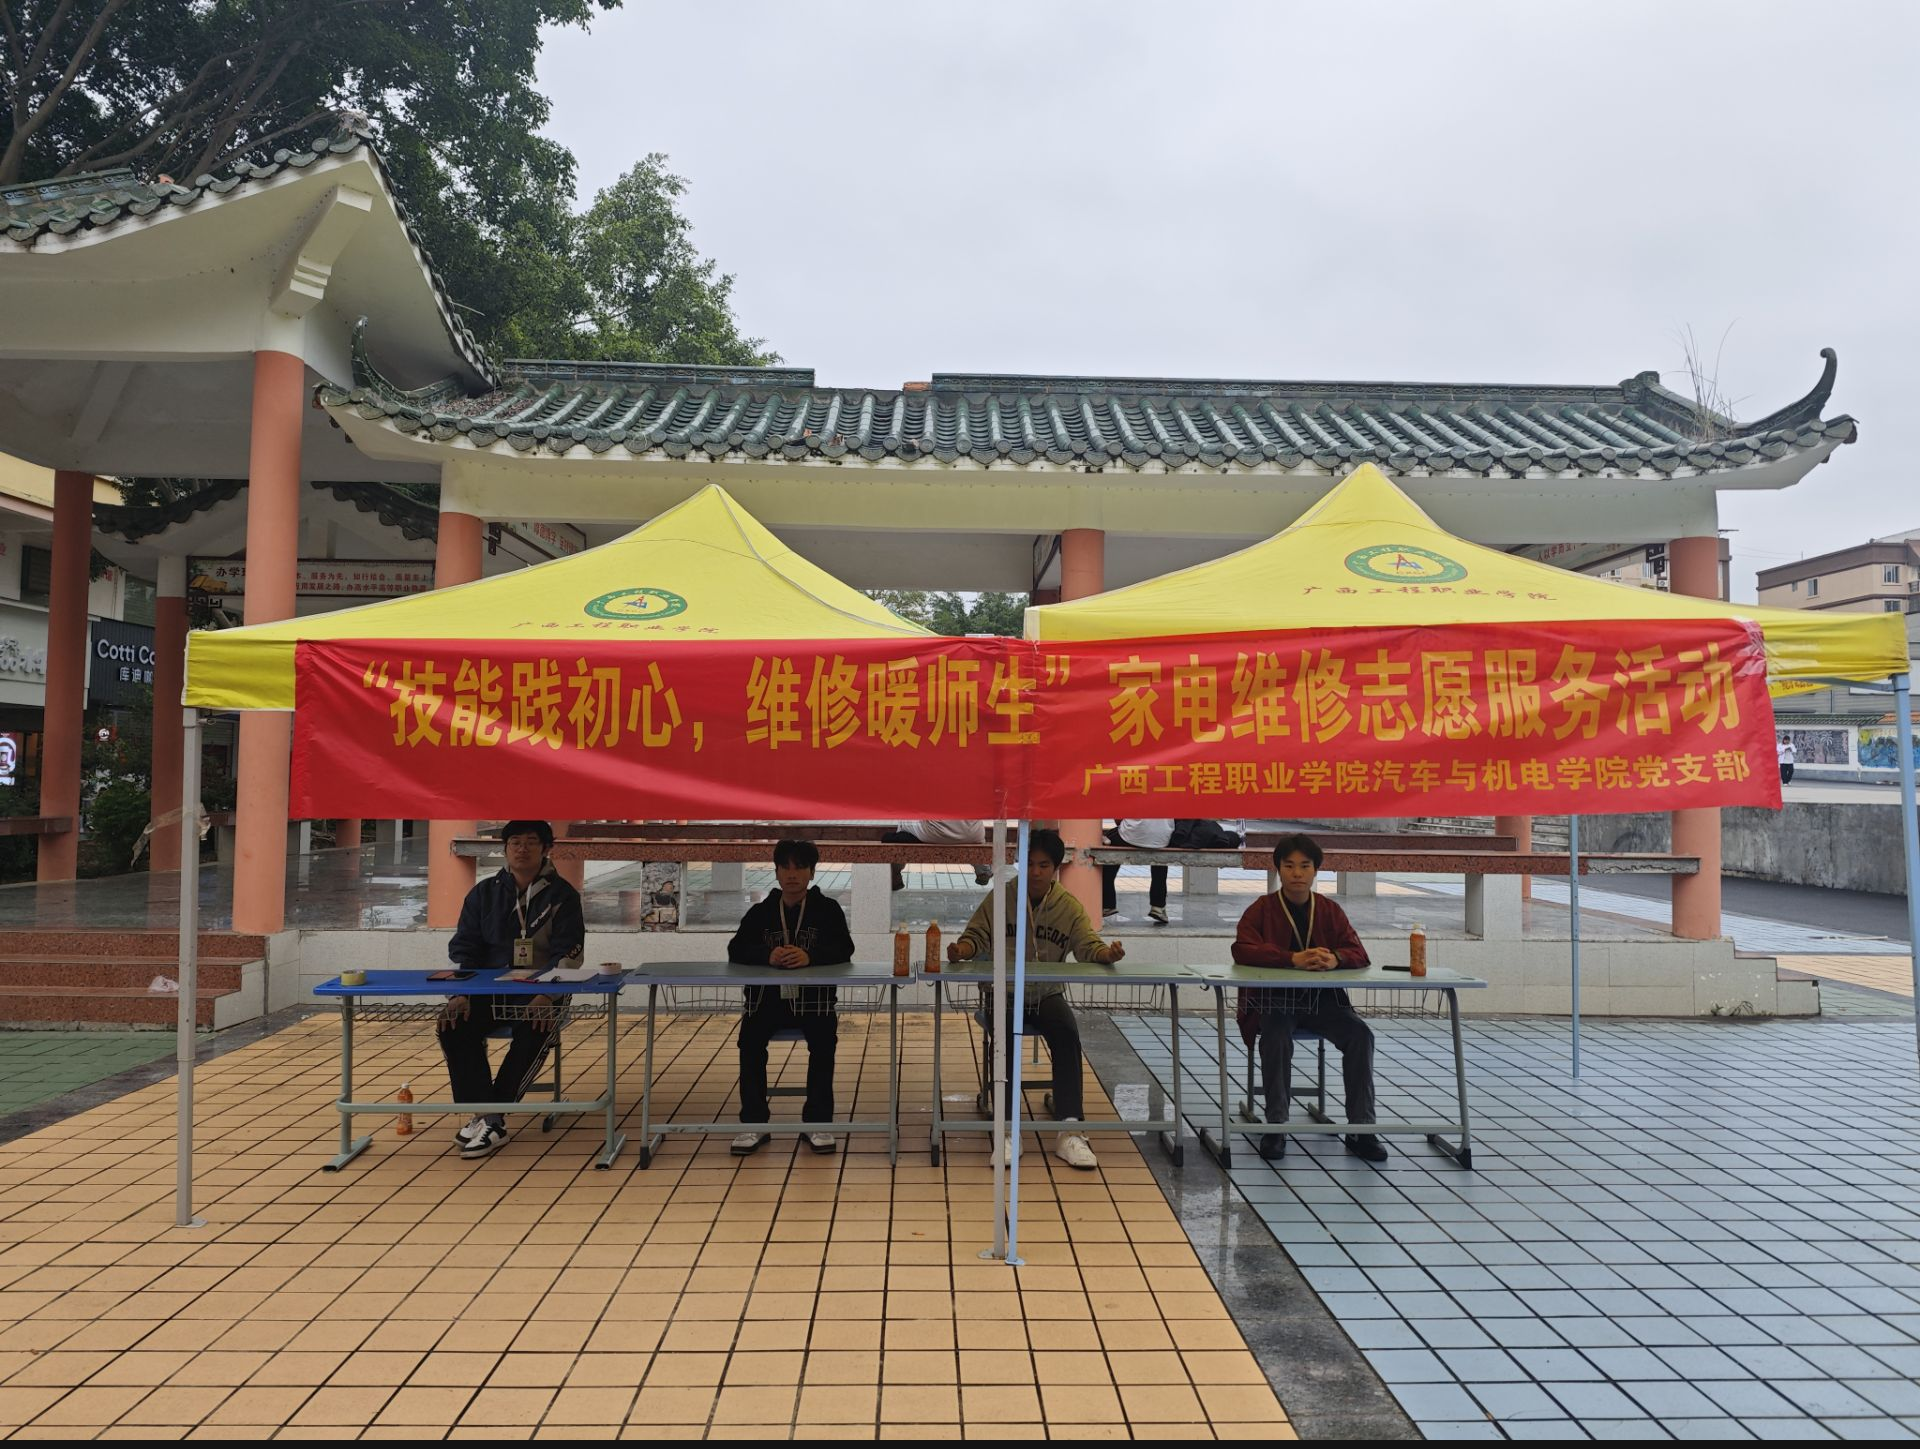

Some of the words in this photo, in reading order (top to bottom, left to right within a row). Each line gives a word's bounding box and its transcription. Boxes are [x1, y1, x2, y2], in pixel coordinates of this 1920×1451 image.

[1303, 586, 1558, 600] 广西工程职业学院
[97, 639, 135, 662] Cotti
[1082, 749, 1750, 798] 广西工程职业学院汽车与机电学院党支部
